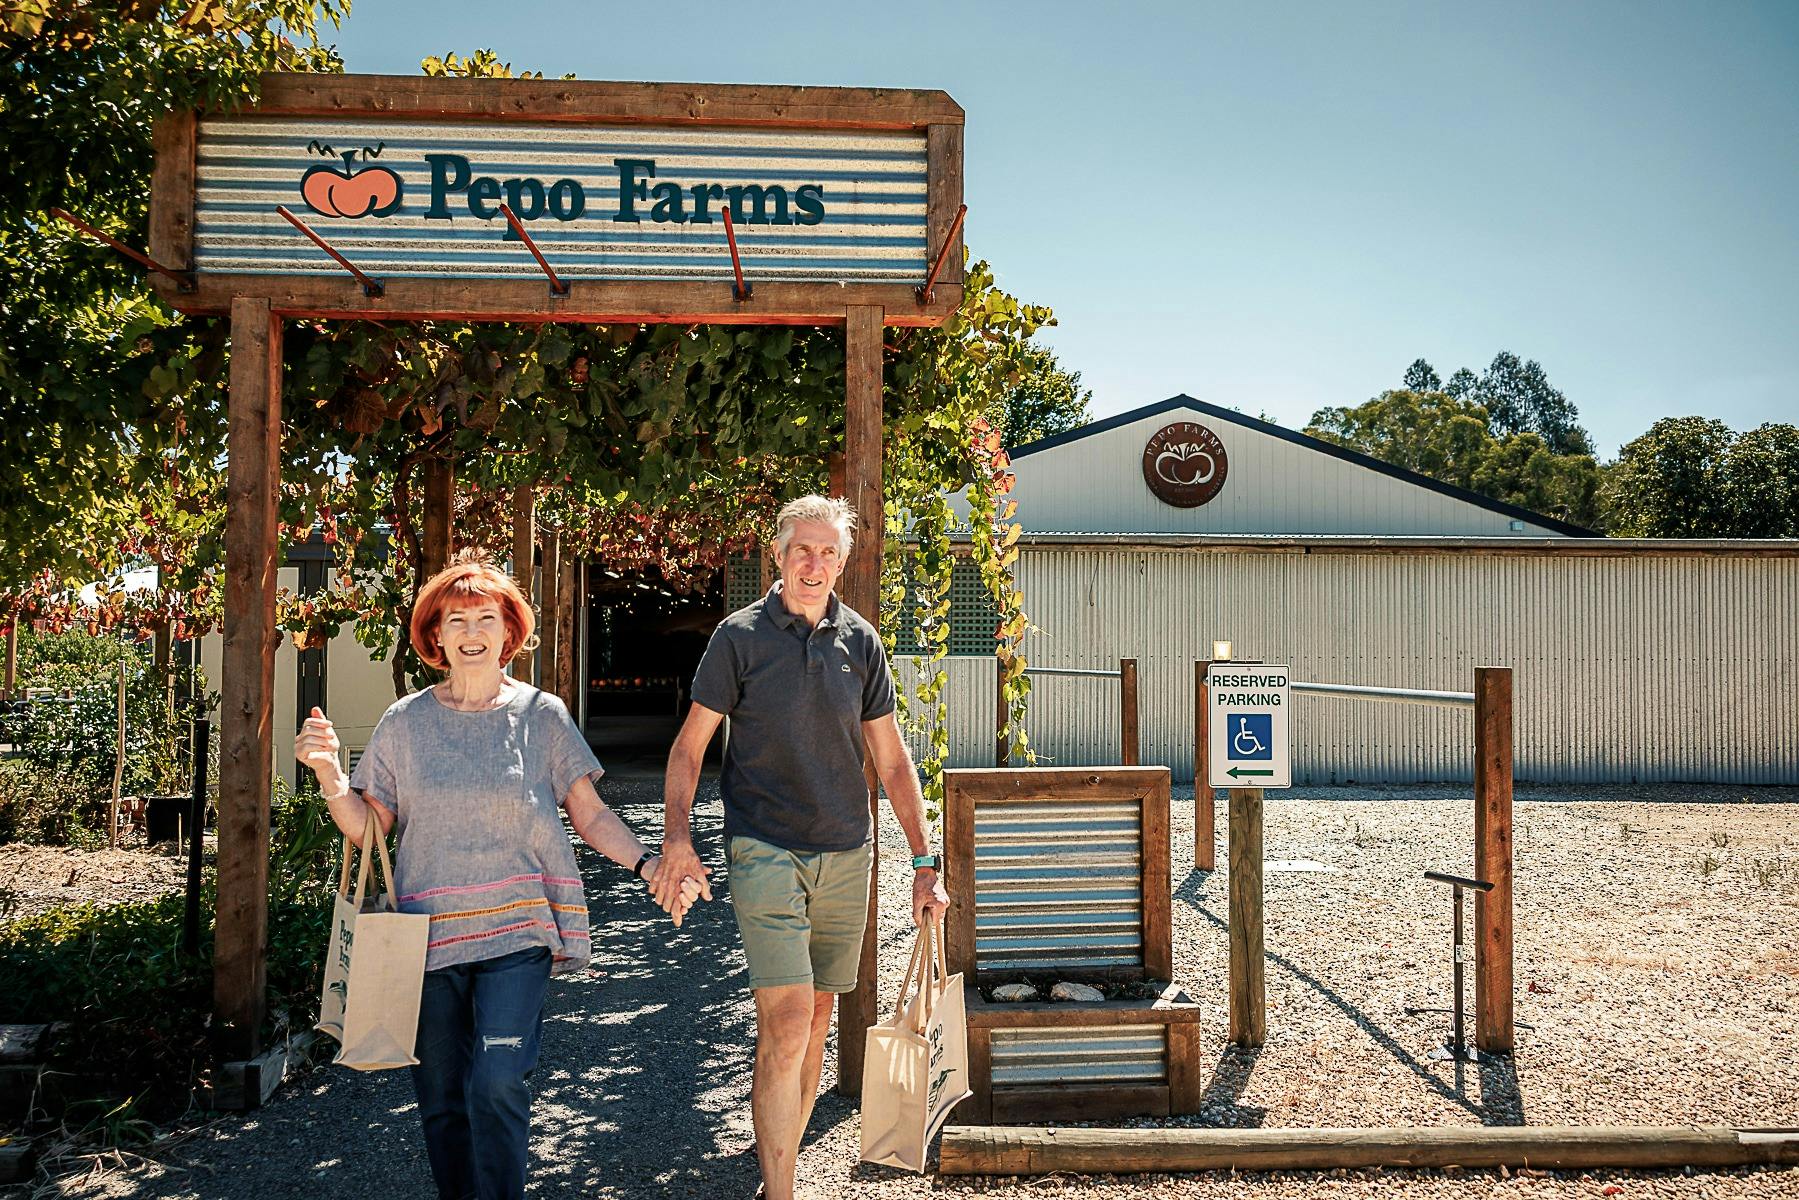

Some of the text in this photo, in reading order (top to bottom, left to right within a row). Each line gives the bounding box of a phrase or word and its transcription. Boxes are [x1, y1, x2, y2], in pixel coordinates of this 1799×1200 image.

[424, 153, 825, 241] Pepo Farms
[1146, 424, 1224, 456] PEPO FARMS
[1212, 675, 1287, 687] RESERVED
[1218, 693, 1281, 706] PARKING
